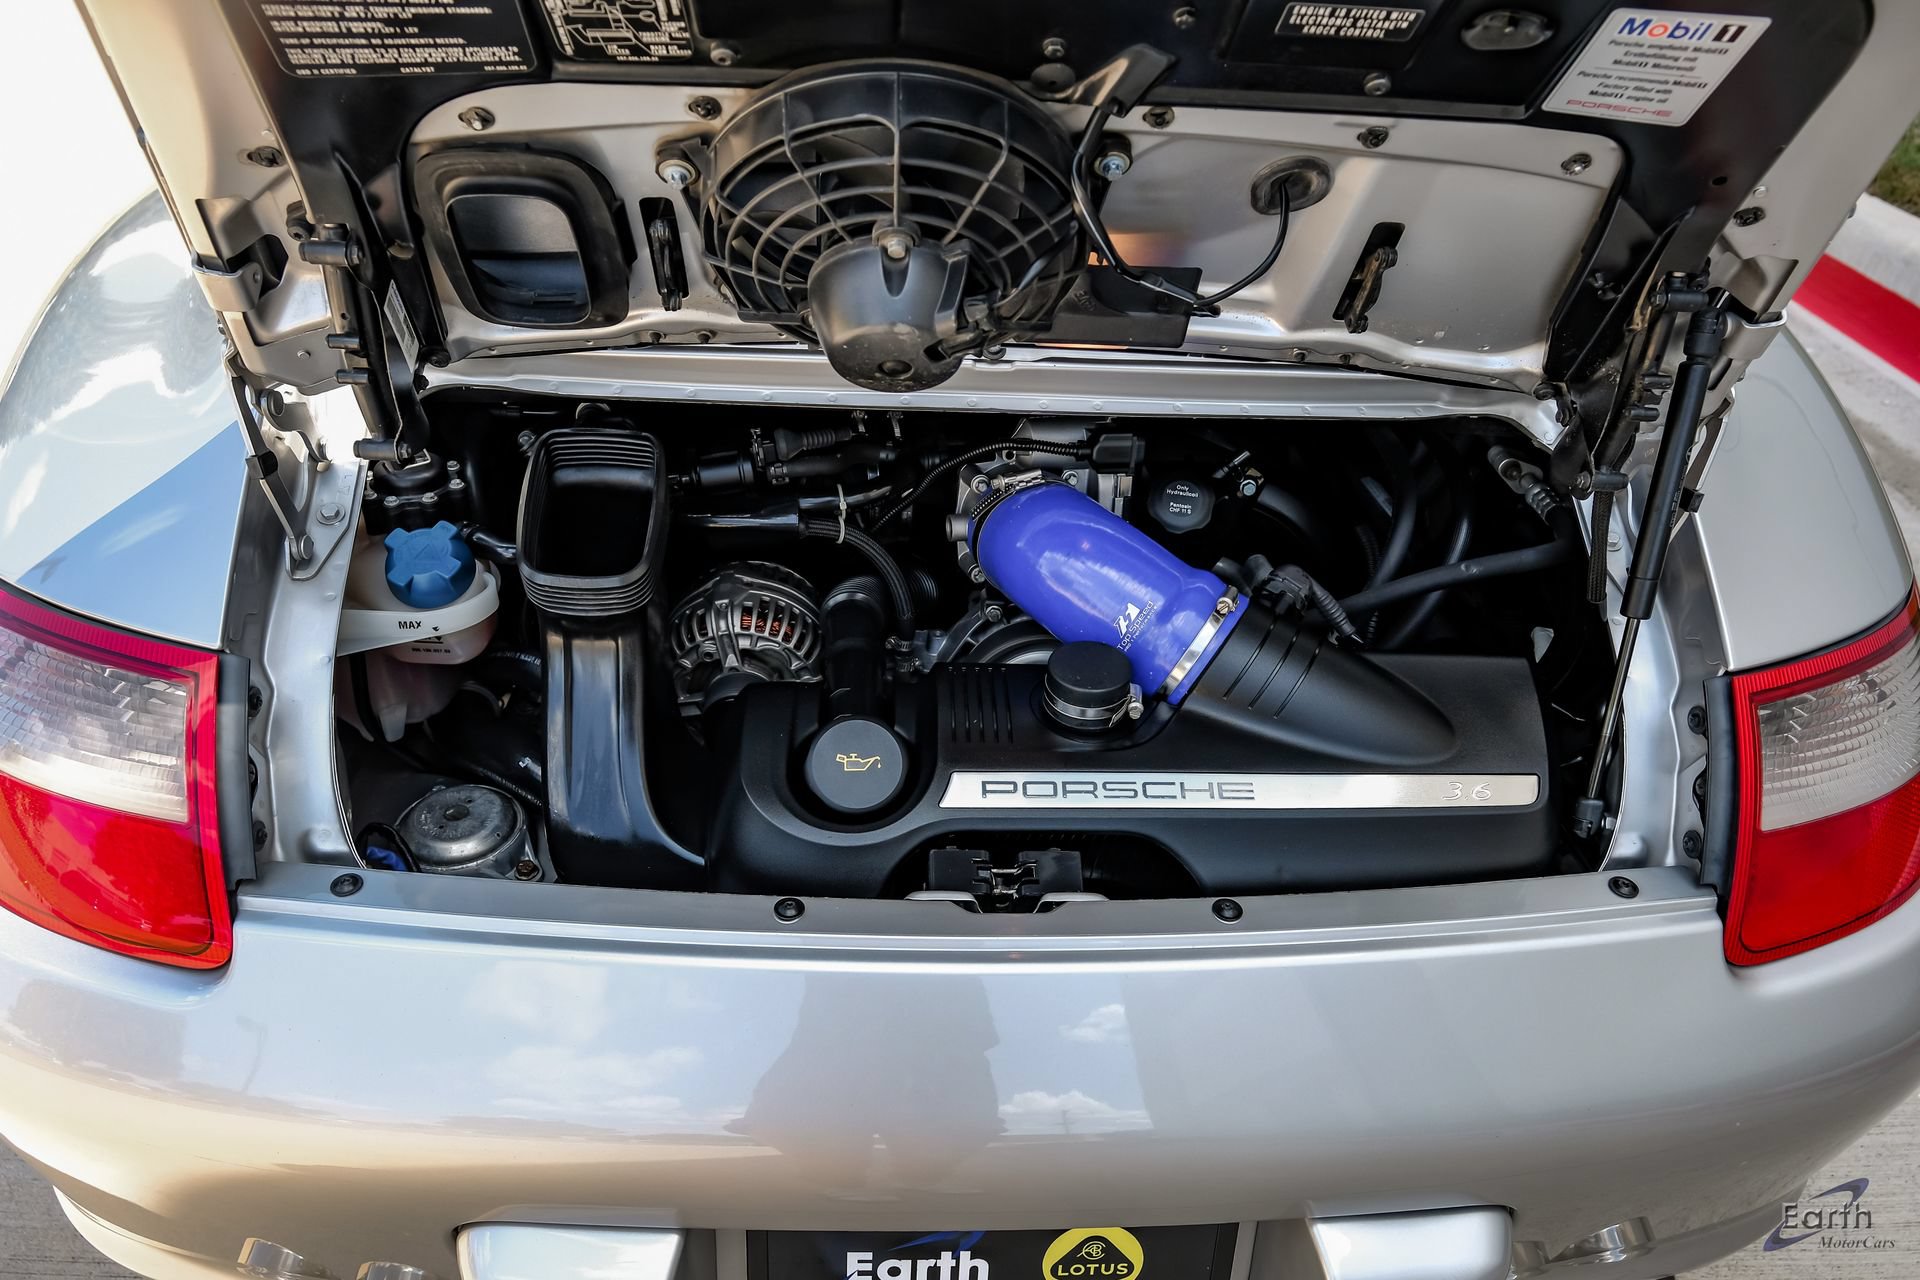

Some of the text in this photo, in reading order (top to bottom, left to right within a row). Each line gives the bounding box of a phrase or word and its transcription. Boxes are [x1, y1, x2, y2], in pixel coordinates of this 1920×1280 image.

[1292, 5, 1417, 21] ENGINE IS FITTED WITH
[1289, 14, 1354, 26] ELECTRONIC
[1302, 25, 1386, 38] KNOCK CONTROL
[1617, 17, 1713, 41] Mobil
[1608, 40, 1644, 48] Porsche
[1577, 71, 1613, 80] Porsche
[1597, 82, 1629, 92] Factory
[1632, 85, 1654, 94] filled
[1625, 94, 1654, 104] engine
[1566, 100, 1673, 117] PORSCHE
[1176, 484, 1189, 492] Only
[398, 621, 422, 630] MAX
[1117, 601, 1154, 649] Top Speed
[981, 781, 1255, 801] PORSCHE
[1442, 782, 1492, 802] 3.6
[845, 1251, 989, 1280] Earth
[1057, 1263, 1128, 1276] LOTUS
